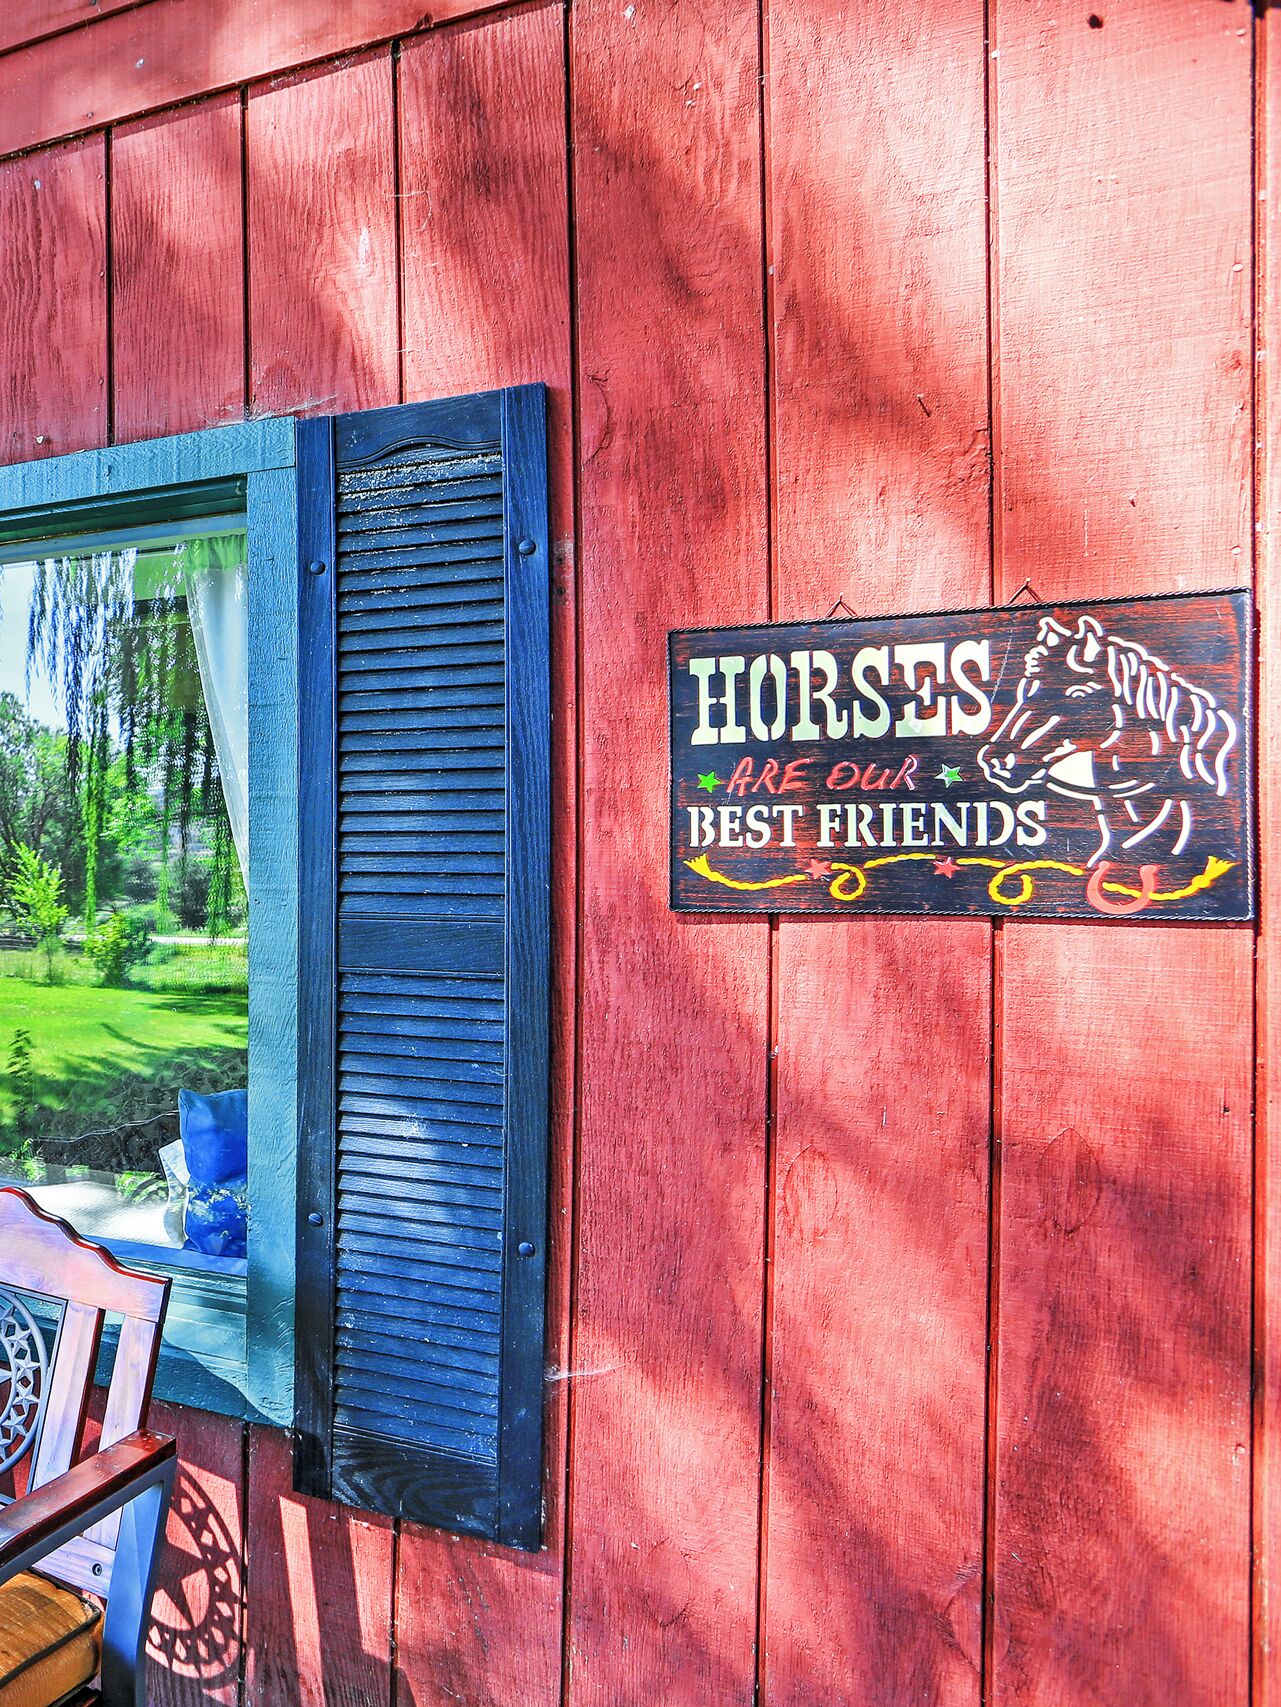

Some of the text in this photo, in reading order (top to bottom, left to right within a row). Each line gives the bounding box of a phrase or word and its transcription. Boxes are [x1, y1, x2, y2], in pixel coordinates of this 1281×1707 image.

[688, 639, 992, 746] HORSES
[726, 756, 812, 797] ARE
[686, 800, 1047, 849] BEST FRIENDS
